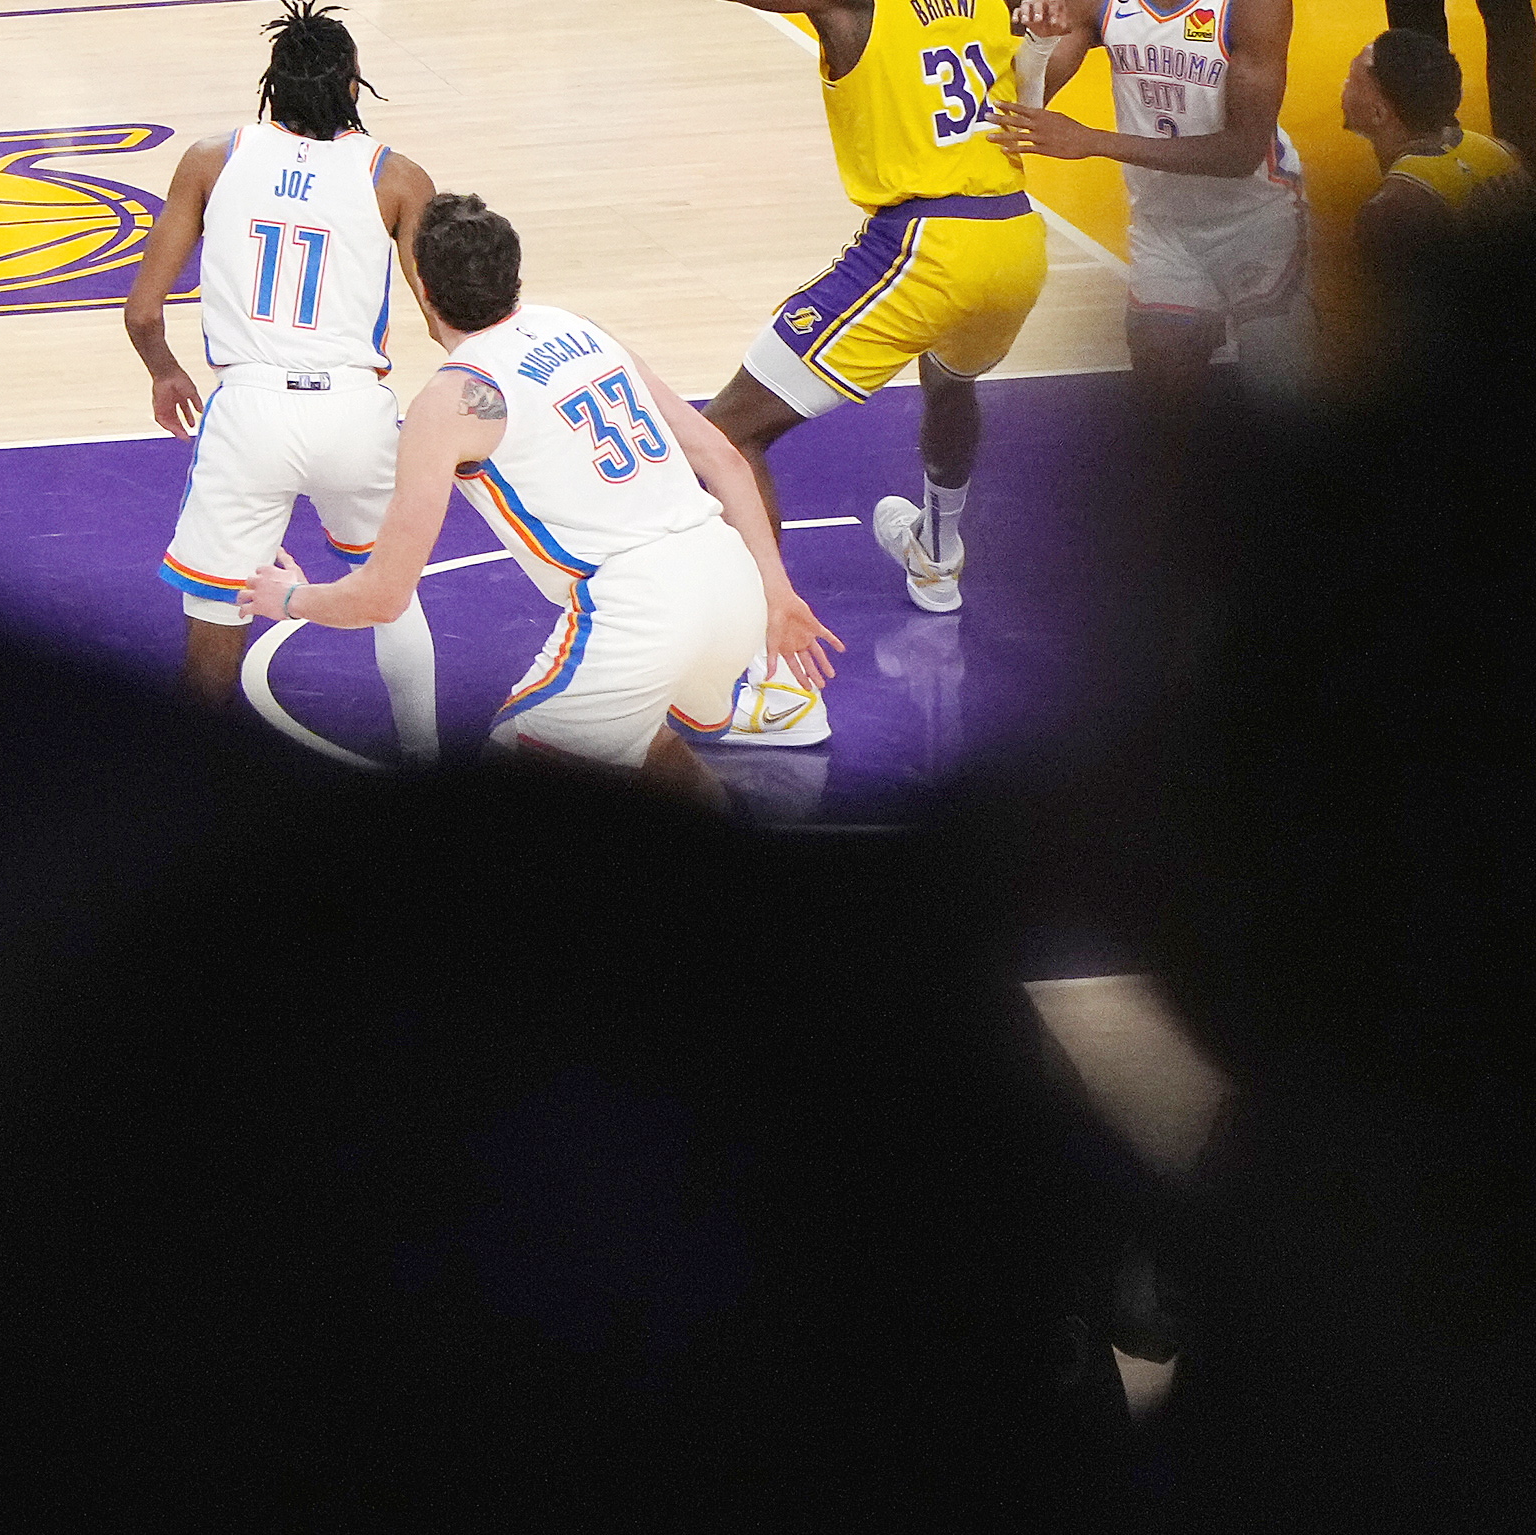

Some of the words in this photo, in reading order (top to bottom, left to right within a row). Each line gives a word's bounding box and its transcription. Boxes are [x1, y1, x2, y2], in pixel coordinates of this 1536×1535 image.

[923, 42, 998, 148] 31
[1141, 82, 1187, 116] CITY
[274, 168, 317, 202] JOE
[248, 217, 331, 332] 11
[516, 330, 605, 387] MUSCALA
[554, 366, 672, 484] 33
